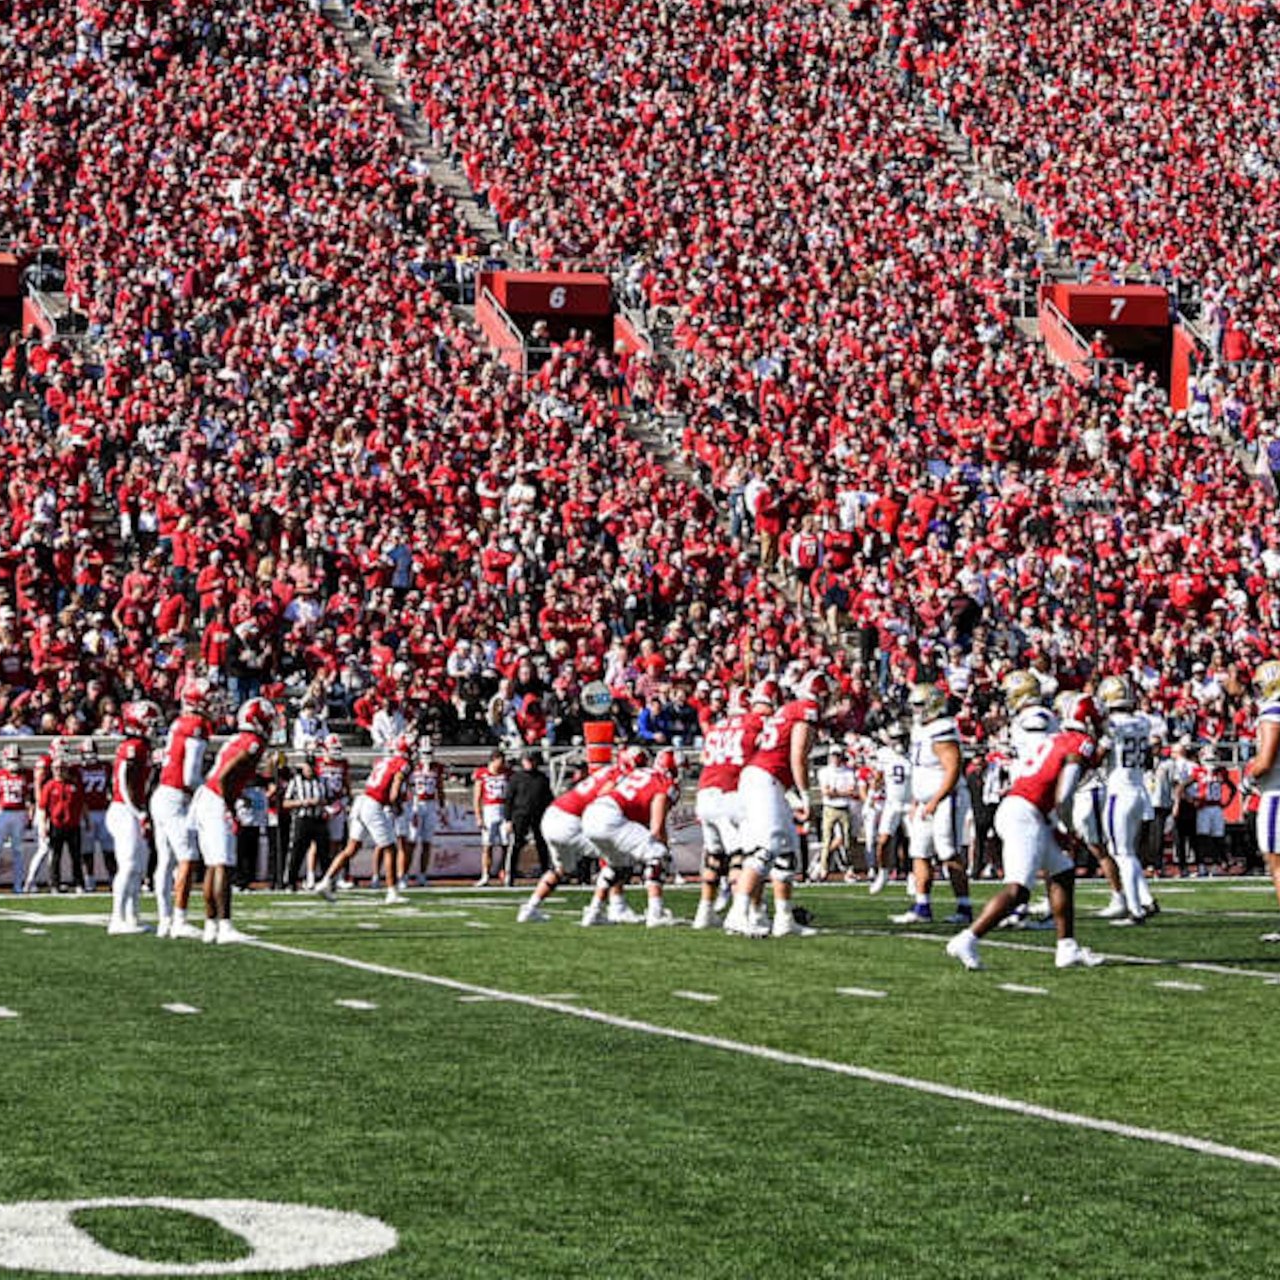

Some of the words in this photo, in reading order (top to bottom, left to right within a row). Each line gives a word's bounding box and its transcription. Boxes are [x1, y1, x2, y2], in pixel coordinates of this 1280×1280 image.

[548, 286, 566, 308] 6
[1109, 297, 1127, 321] 7
[892, 764, 905, 785] 9
